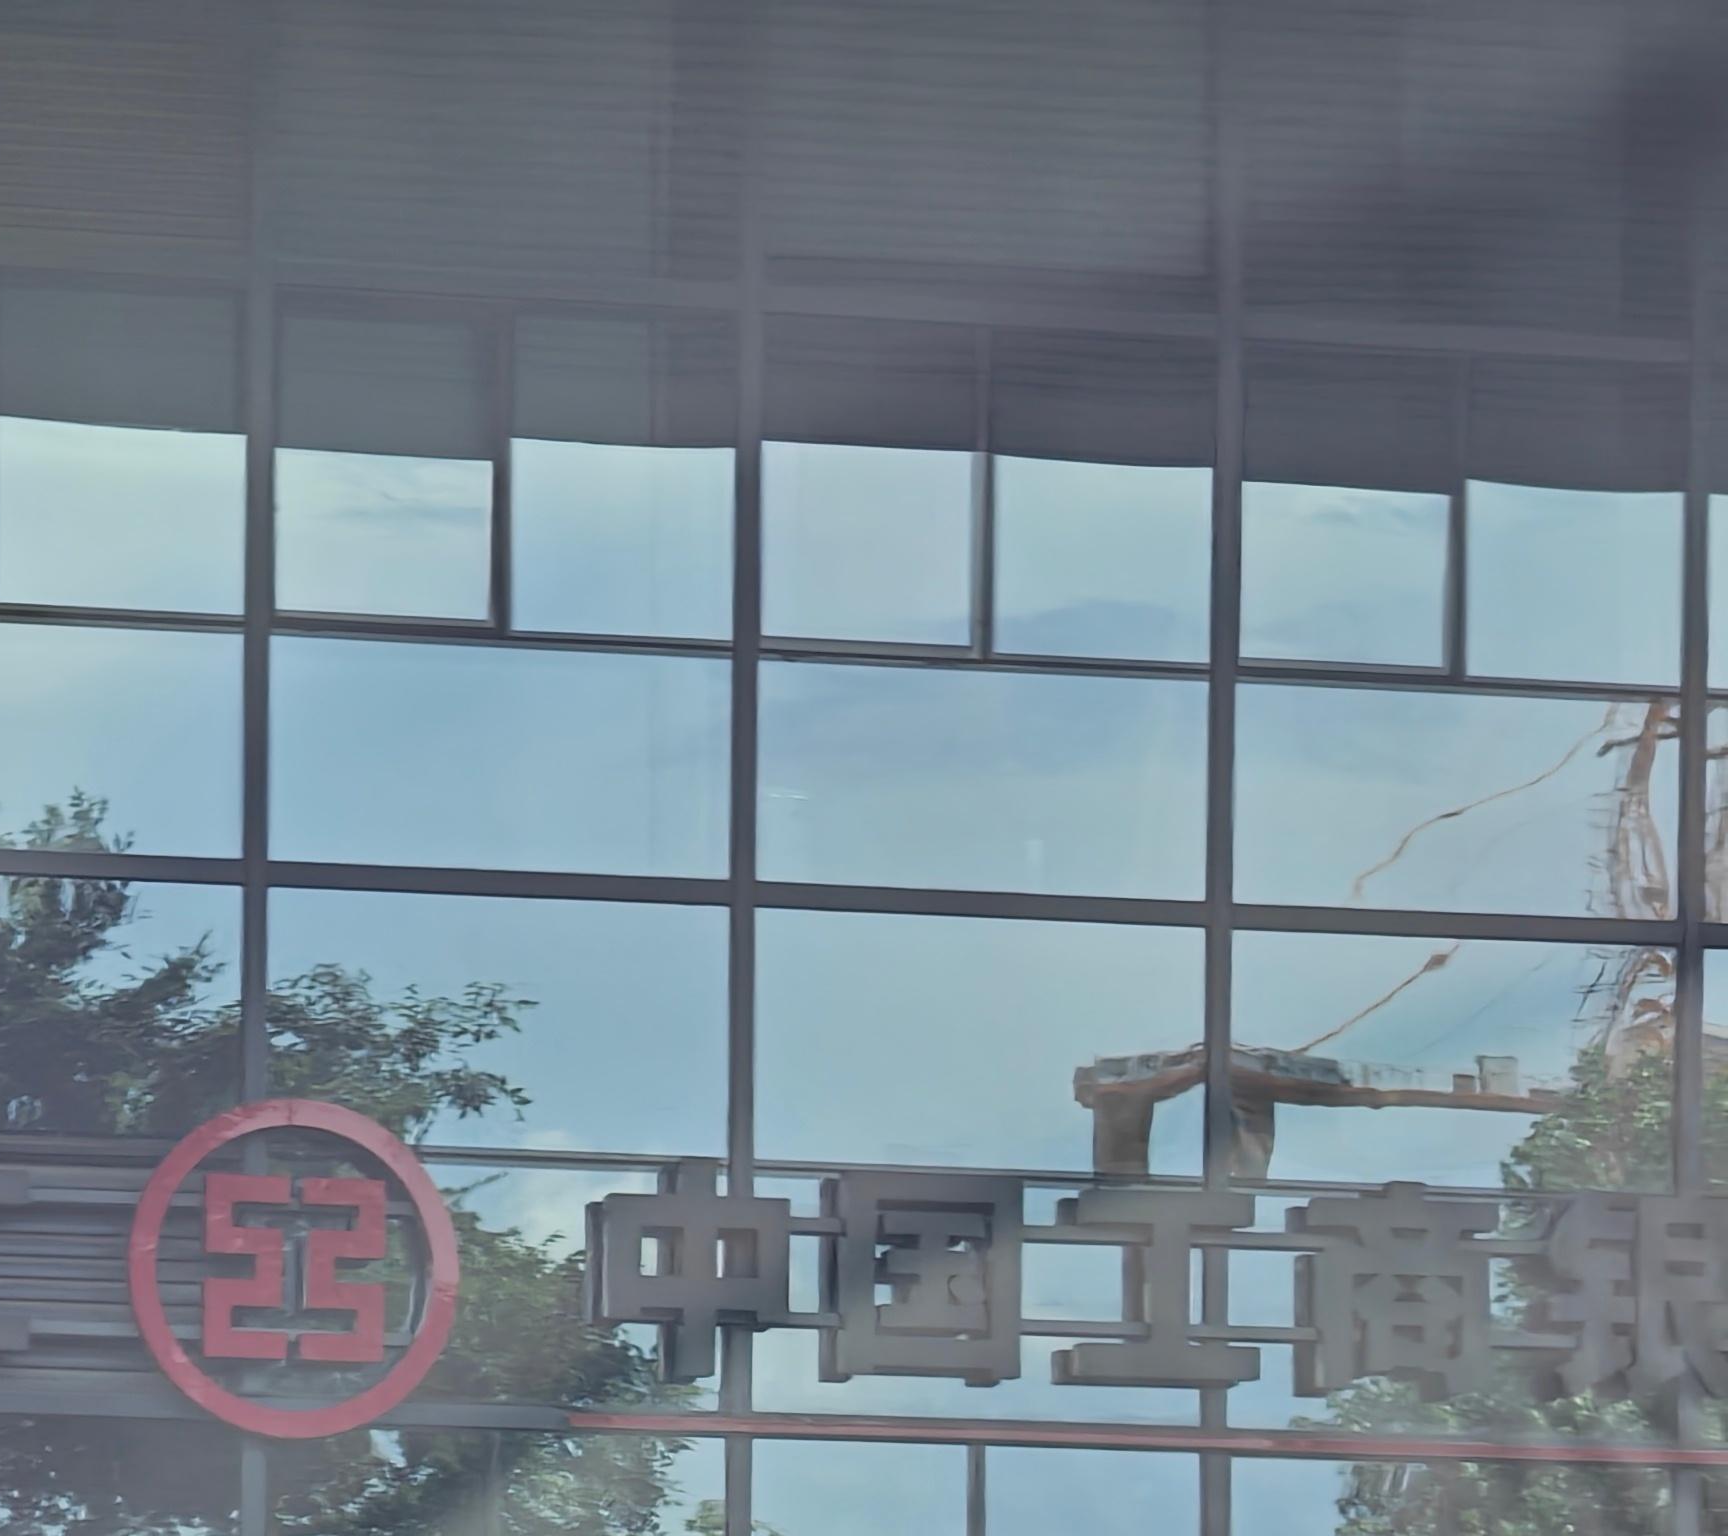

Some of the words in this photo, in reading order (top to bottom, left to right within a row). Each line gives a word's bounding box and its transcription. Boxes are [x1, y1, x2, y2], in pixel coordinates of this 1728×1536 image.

[590, 1156, 1728, 1394] 中国工商银
